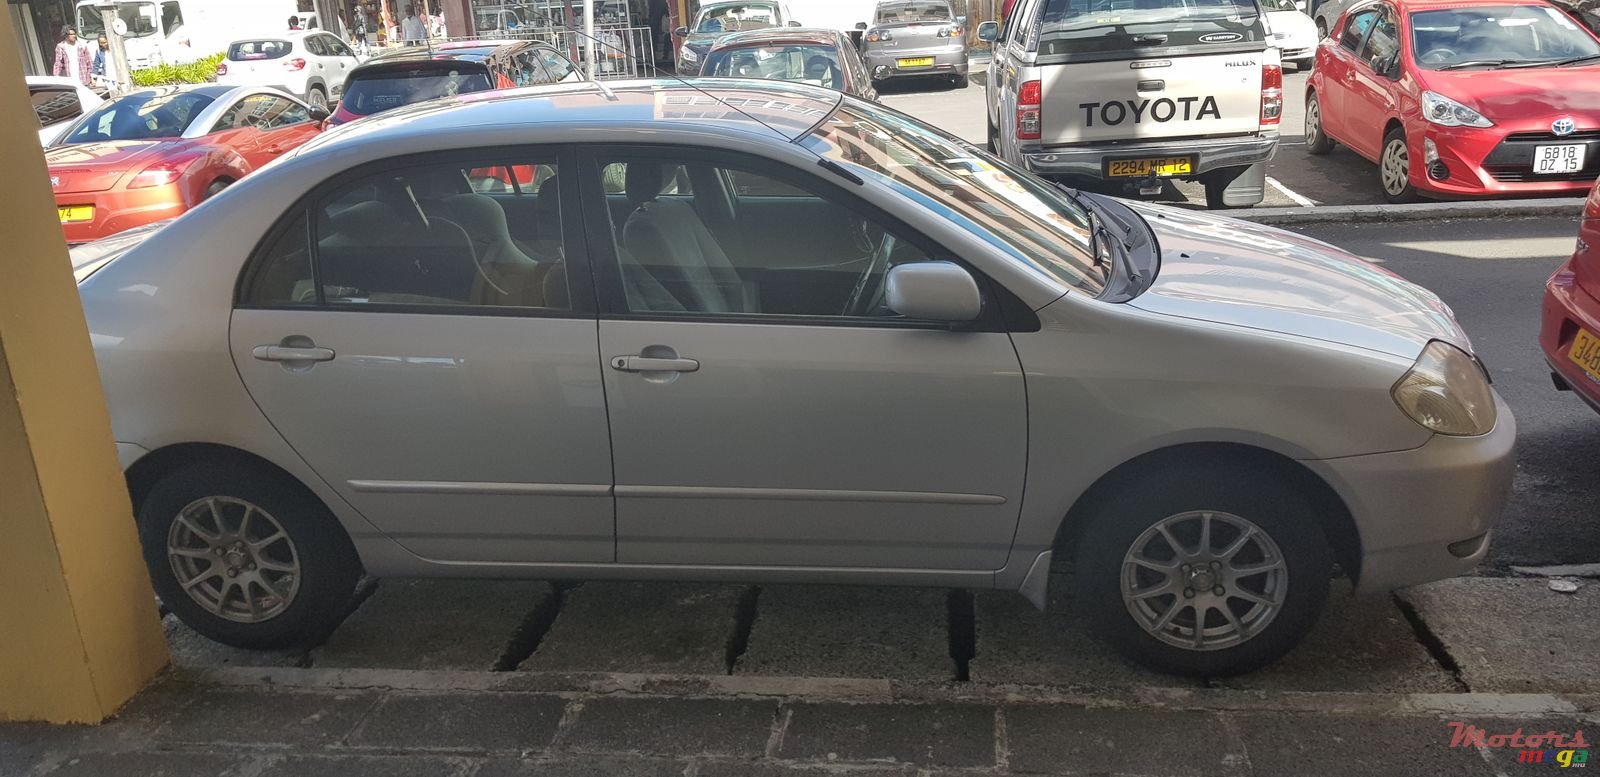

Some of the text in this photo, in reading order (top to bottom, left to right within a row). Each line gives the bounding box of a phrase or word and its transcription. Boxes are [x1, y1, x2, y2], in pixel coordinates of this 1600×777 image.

[1079, 95, 1222, 128] TOYOTA
[1544, 146, 1576, 159] 6818
[1112, 158, 1187, 175] 2294 MR 12
[1540, 157, 1578, 171] DZ 15
